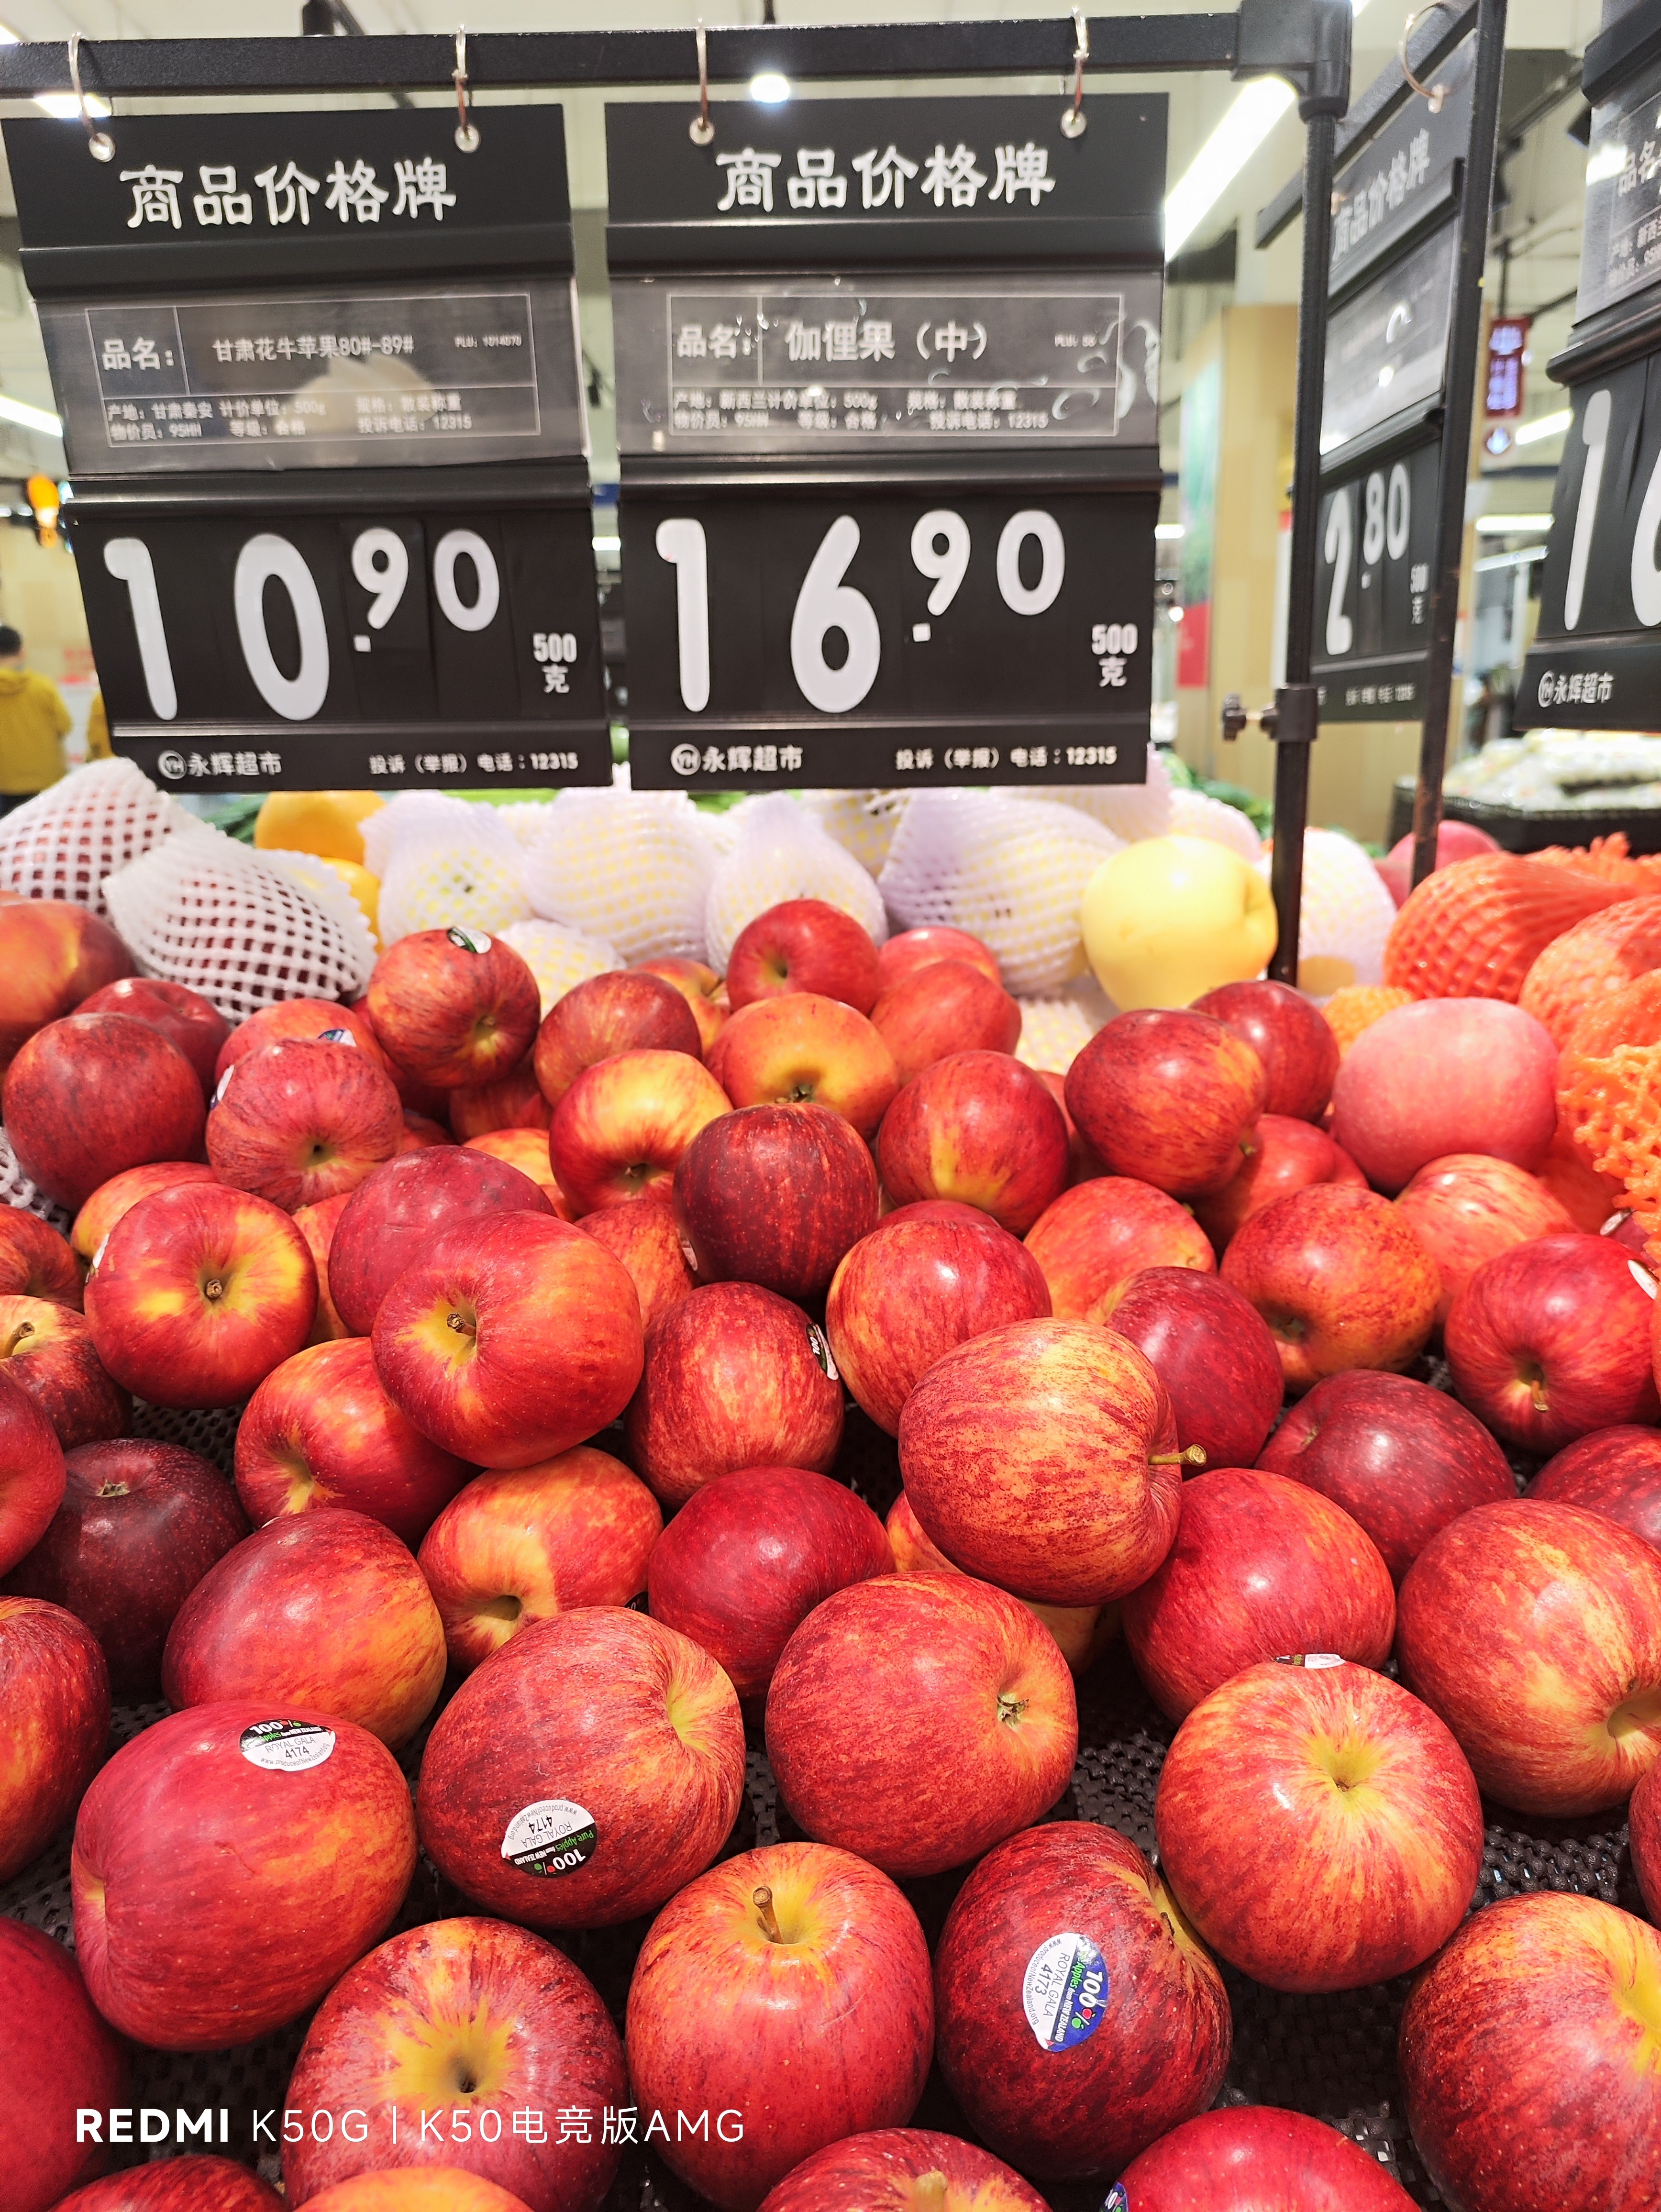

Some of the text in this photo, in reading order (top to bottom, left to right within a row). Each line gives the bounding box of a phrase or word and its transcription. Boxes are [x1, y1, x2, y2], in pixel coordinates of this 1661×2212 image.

[716, 142, 1055, 212] 商品价格牌
[120, 156, 456, 229] 商品价格牌
[533, 633, 577, 663] 500
[1091, 623, 1138, 654] 500
[543, 665, 570, 694] 克
[1098, 656, 1128, 688] 克
[1553, 672, 1615, 704] 永辉超市
[188, 751, 282, 777] 永辉超市
[702, 744, 803, 773] 永辉超市
[265, 1739, 295, 1753] ROYAL
[294, 1736, 316, 1746] GALA
[285, 1746, 310, 1759] 4174
[521, 1821, 573, 1848] ROYAL GALA
[529, 1815, 553, 1834] 4174
[577, 1829, 594, 1842] Pure
[555, 1836, 577, 1852] Apples
[1035, 1963, 1054, 1995] 4173
[1043, 1952, 1070, 2016] ROYAL GALA
[1070, 1961, 1086, 1989] Apples
[1063, 1999, 1074, 2015] NEW
[1054, 2014, 1069, 2043] ZEALAND
